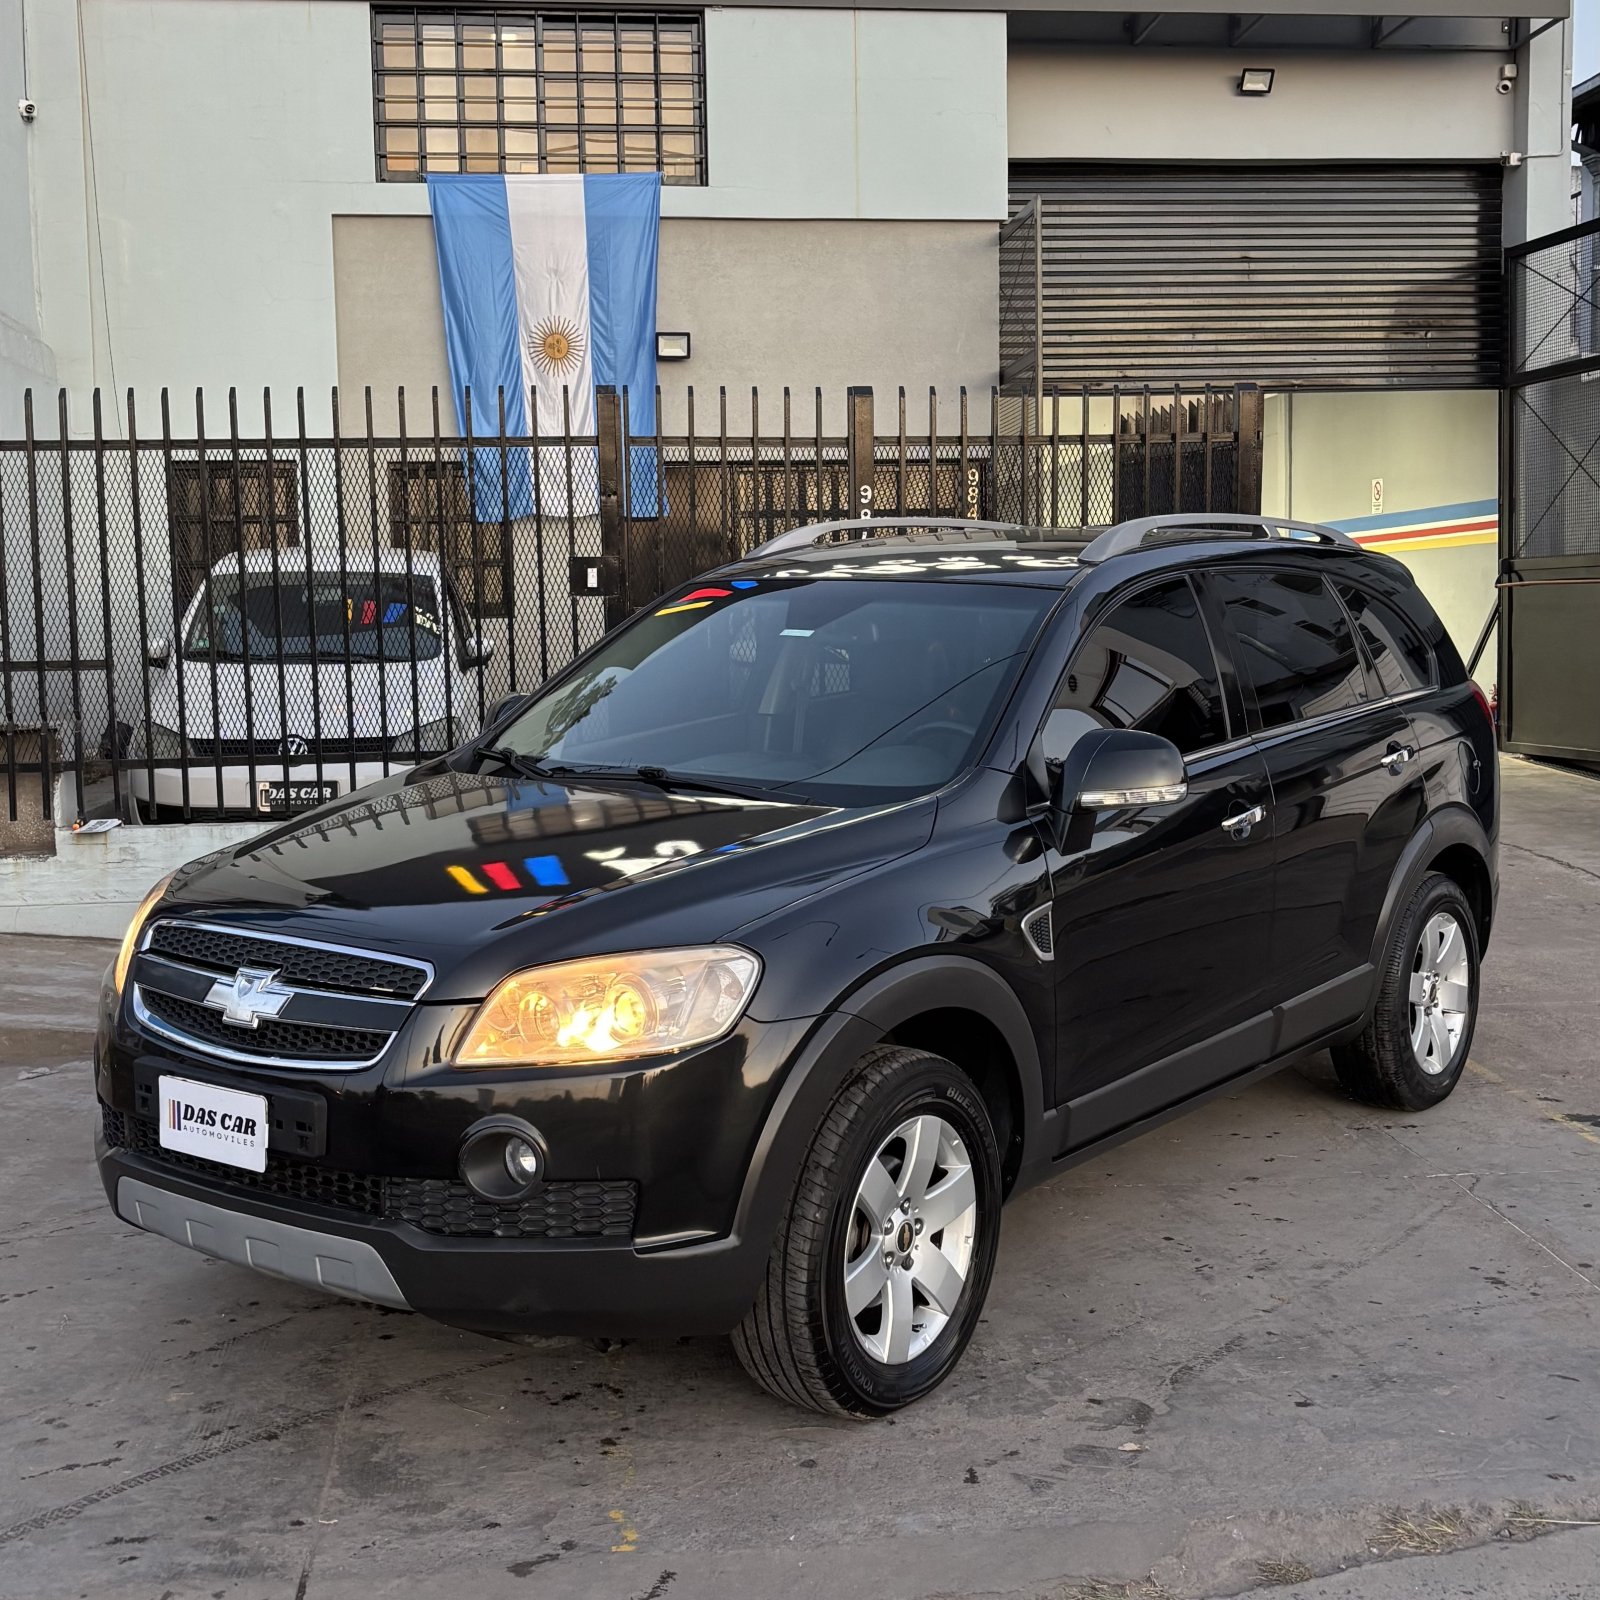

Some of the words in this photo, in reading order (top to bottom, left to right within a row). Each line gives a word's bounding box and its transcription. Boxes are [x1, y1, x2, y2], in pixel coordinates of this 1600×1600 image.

[967, 468, 979, 520] 984
[860, 485, 872, 539] 98
[269, 787, 298, 799] DAS
[300, 787, 332, 799] CAR
[183, 1104, 217, 1127] DAS
[220, 1113, 257, 1136] CAR
[183, 1124, 255, 1147] AUTOMOVILES
